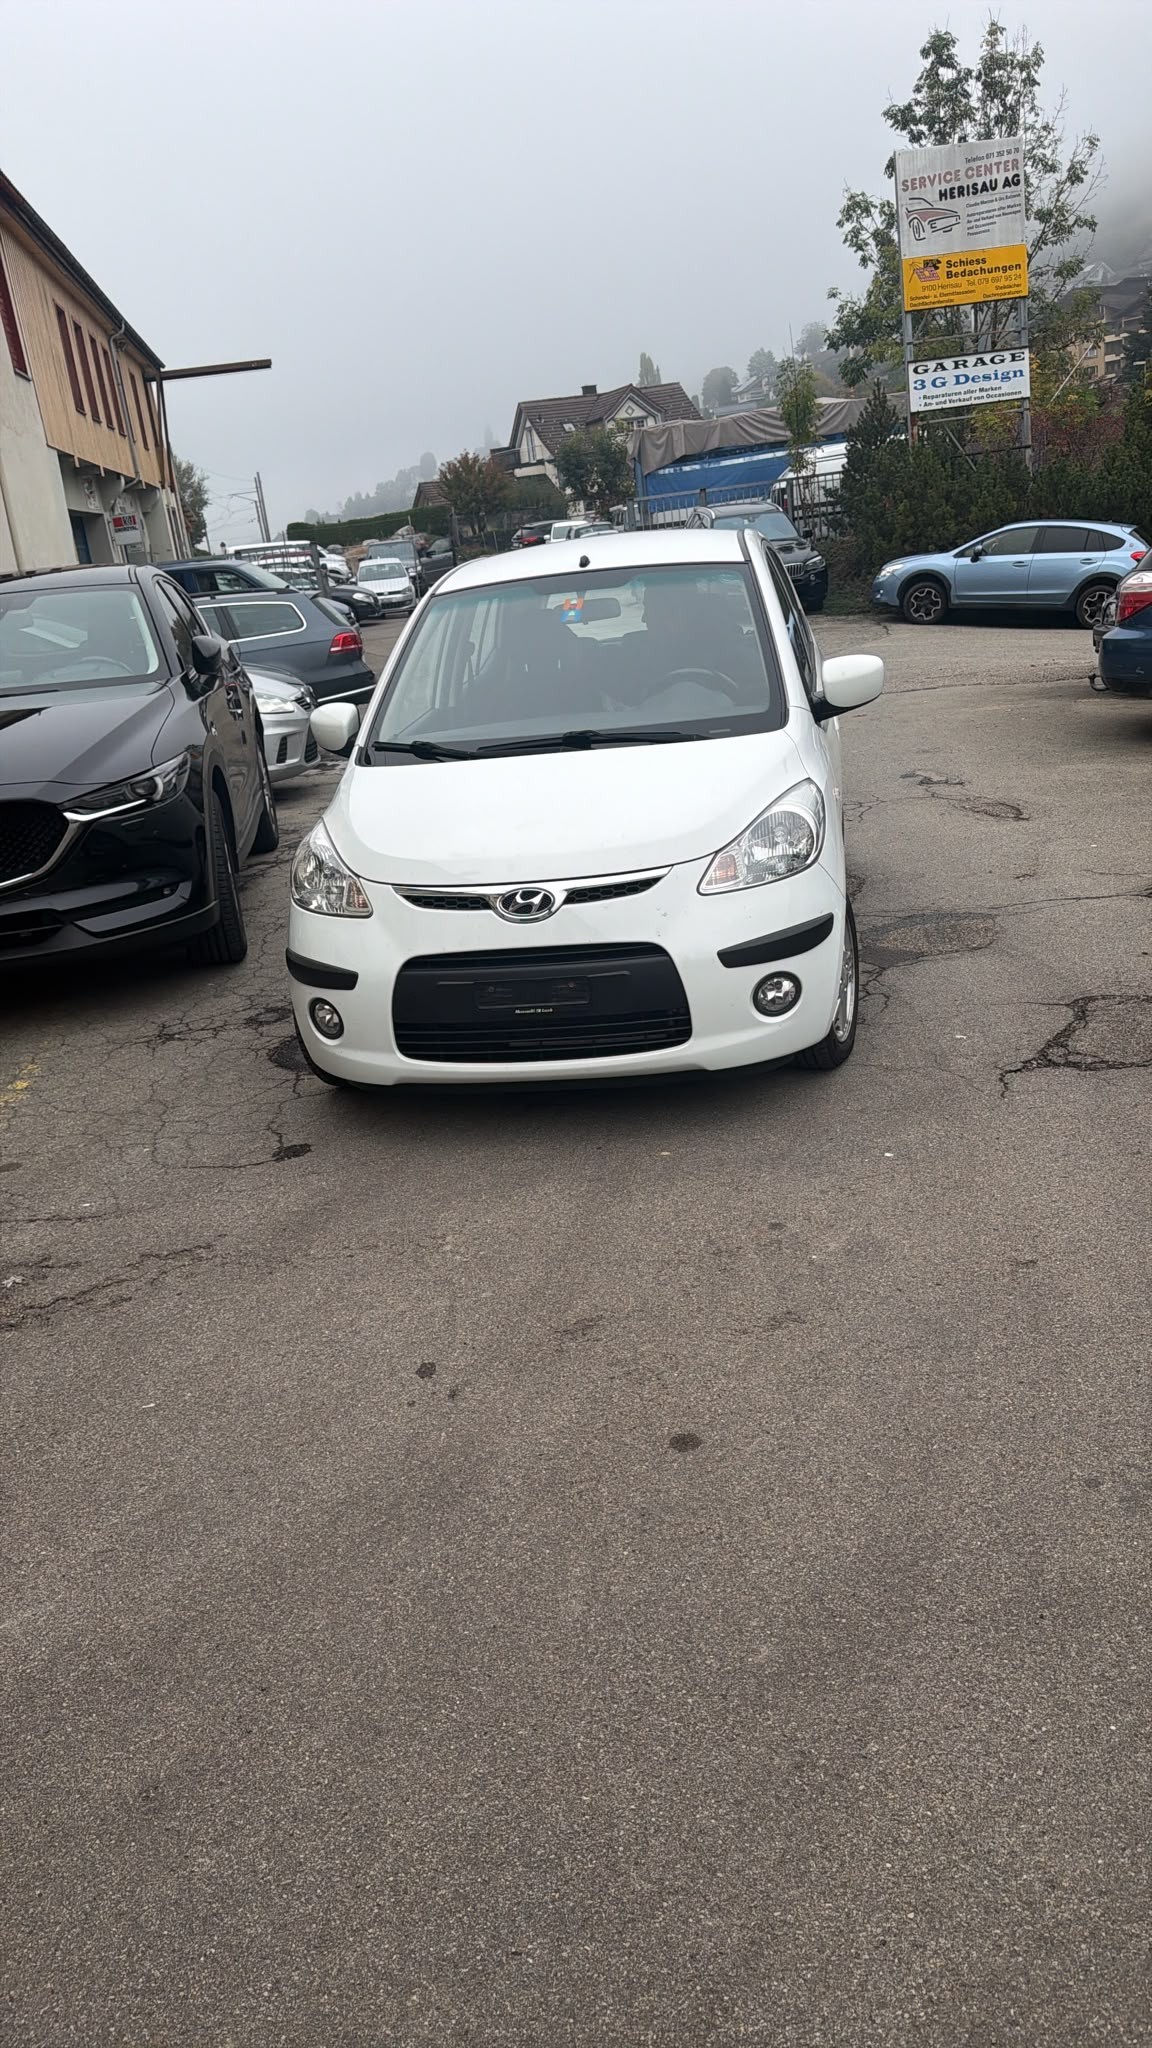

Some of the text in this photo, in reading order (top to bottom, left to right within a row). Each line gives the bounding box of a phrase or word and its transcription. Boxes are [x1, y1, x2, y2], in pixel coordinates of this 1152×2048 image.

[902, 158, 1020, 192] SERVICE CENTER
[939, 174, 1020, 201] HERISAU AG
[946, 257, 986, 268] Schiess
[946, 264, 1021, 279] Bedachungen
[938, 282, 962, 291] Herisau
[913, 352, 1025, 375] GARAGE
[954, 369, 1024, 386] Design
[922, 391, 962, 401] Reparaturen
[948, 396, 972, 404] Verkauf
[986, 390, 1022, 399] Occasionen
